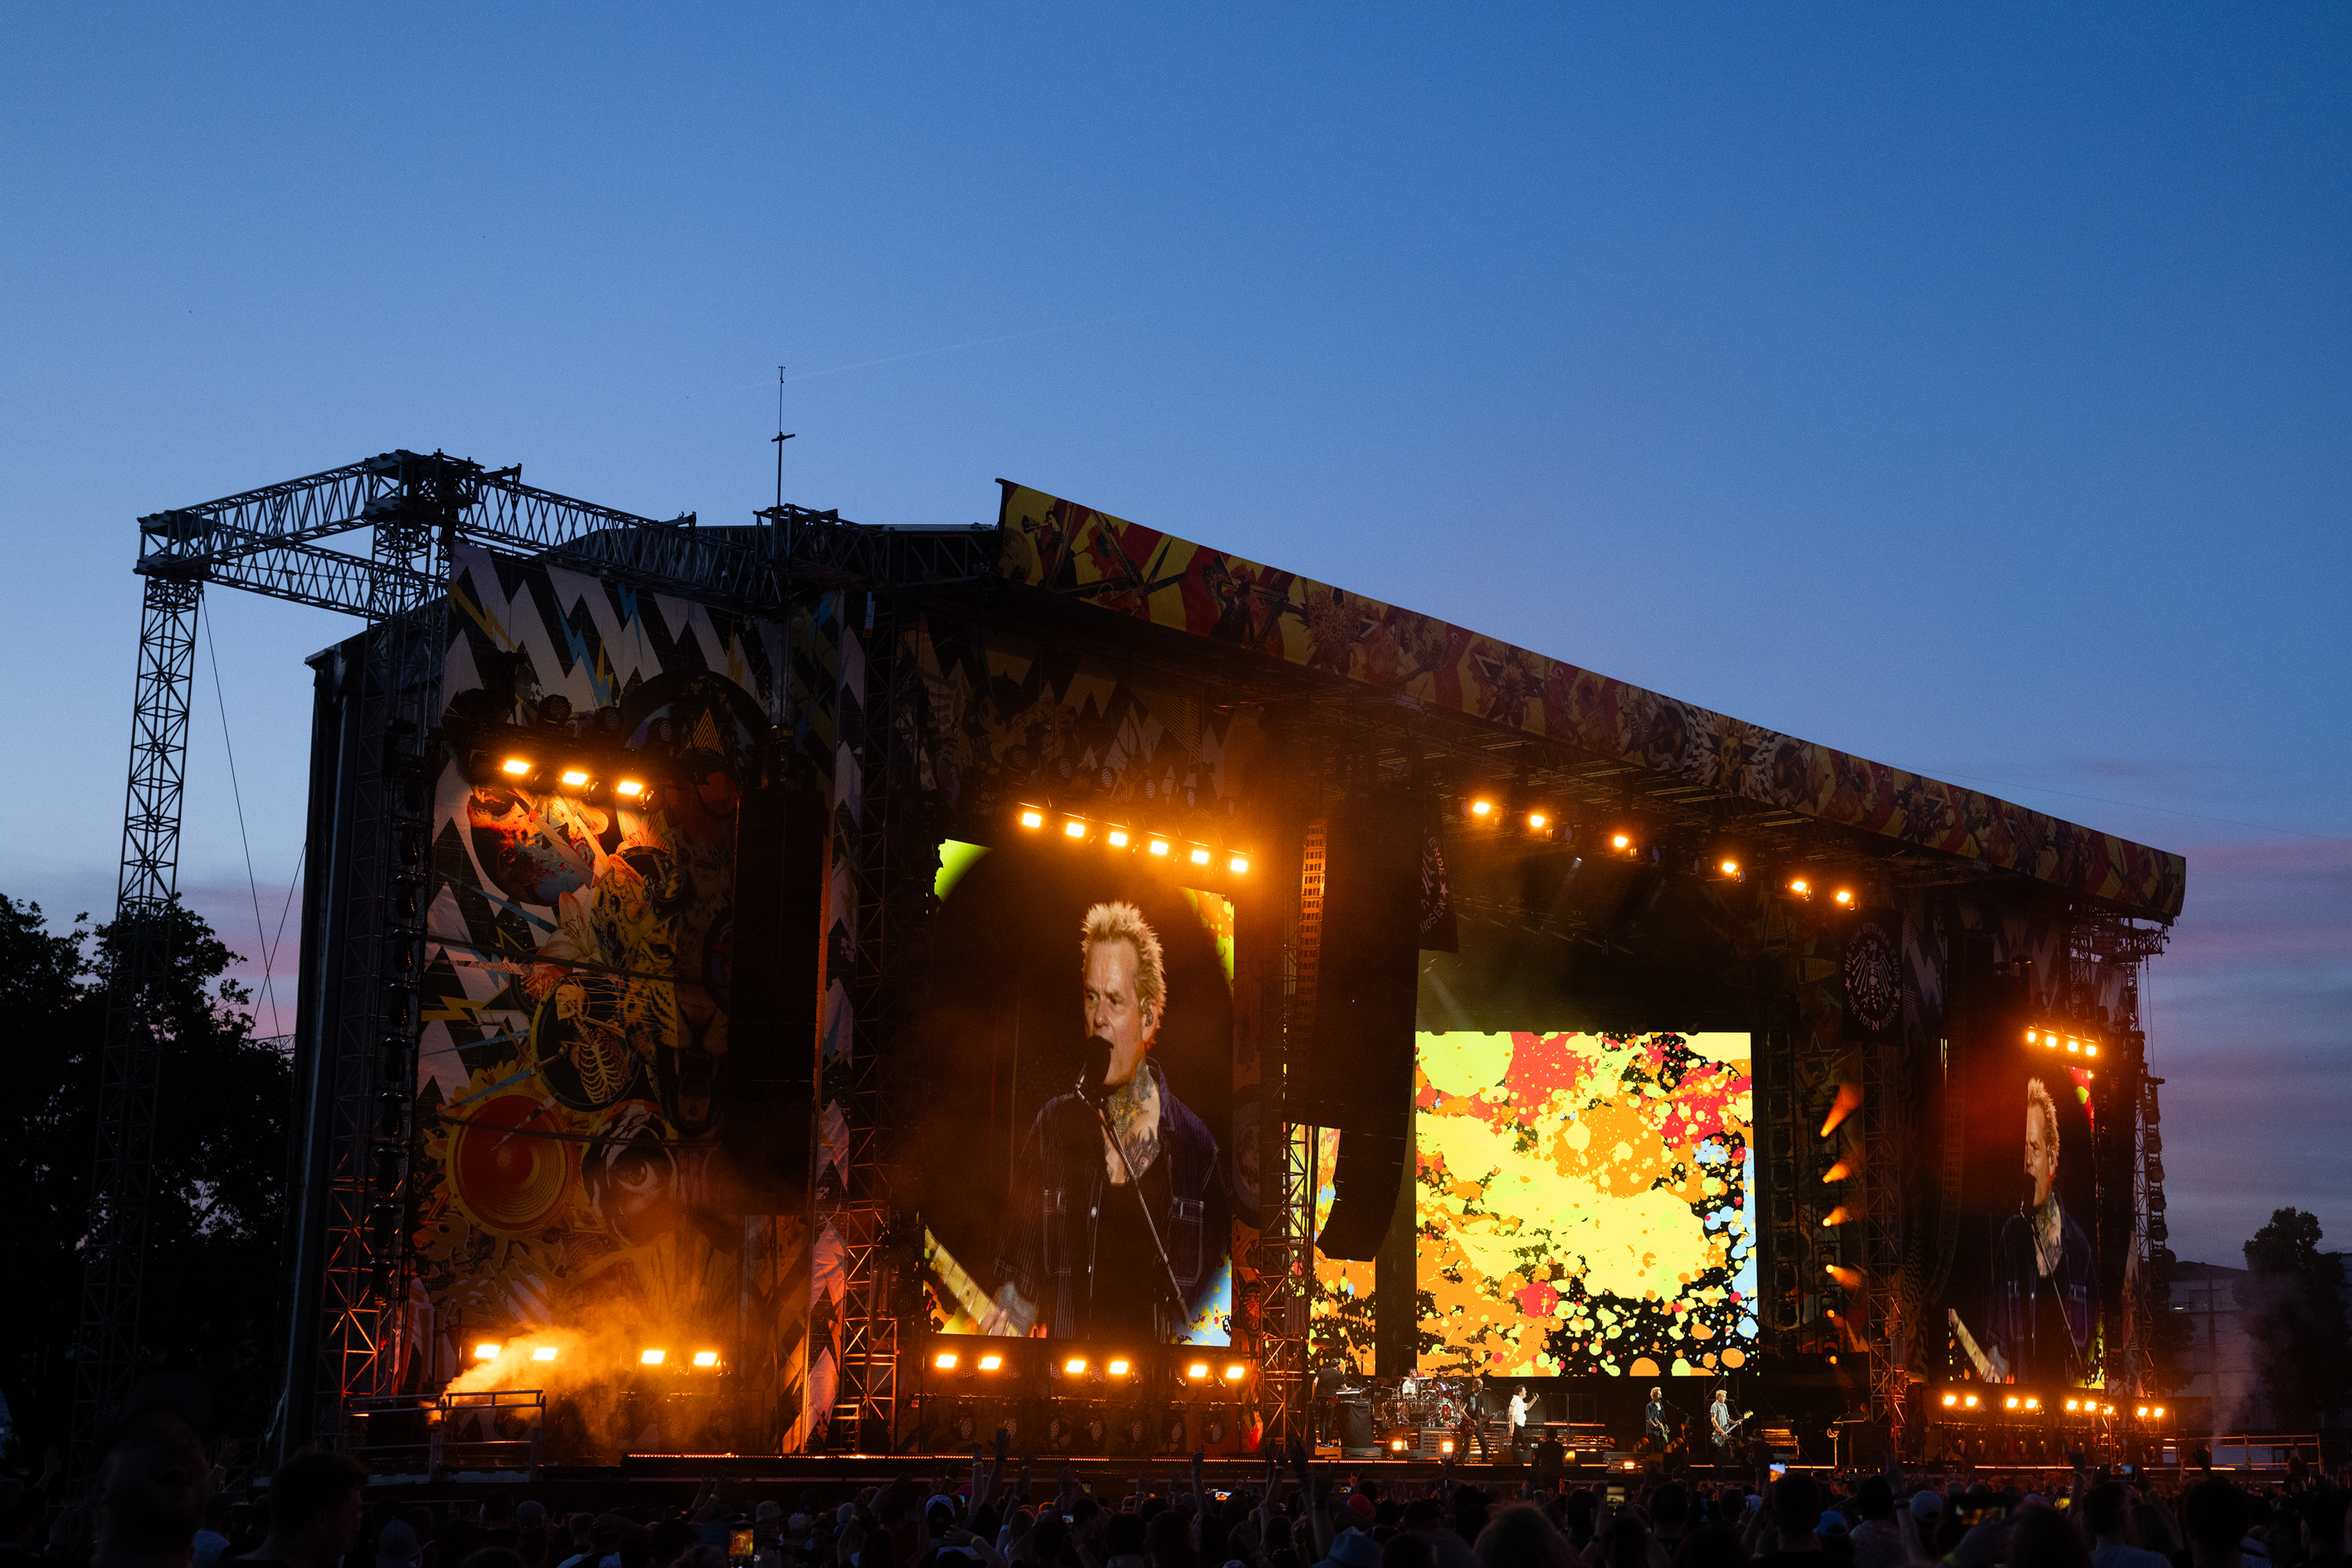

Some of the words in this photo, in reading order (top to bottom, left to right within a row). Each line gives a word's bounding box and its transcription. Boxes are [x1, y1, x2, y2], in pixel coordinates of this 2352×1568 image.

[1428, 836, 1447, 876] ENDE
[1419, 898, 1446, 933] HOSEN
[1848, 928, 1861, 951] ZUM
[1862, 923, 1892, 948] BITTEREN
[1844, 952, 1853, 971] BIS
[1889, 949, 1901, 981] ENDE
[1848, 993, 1859, 1015] DIE
[1881, 1001, 1900, 1030] HOSEN
